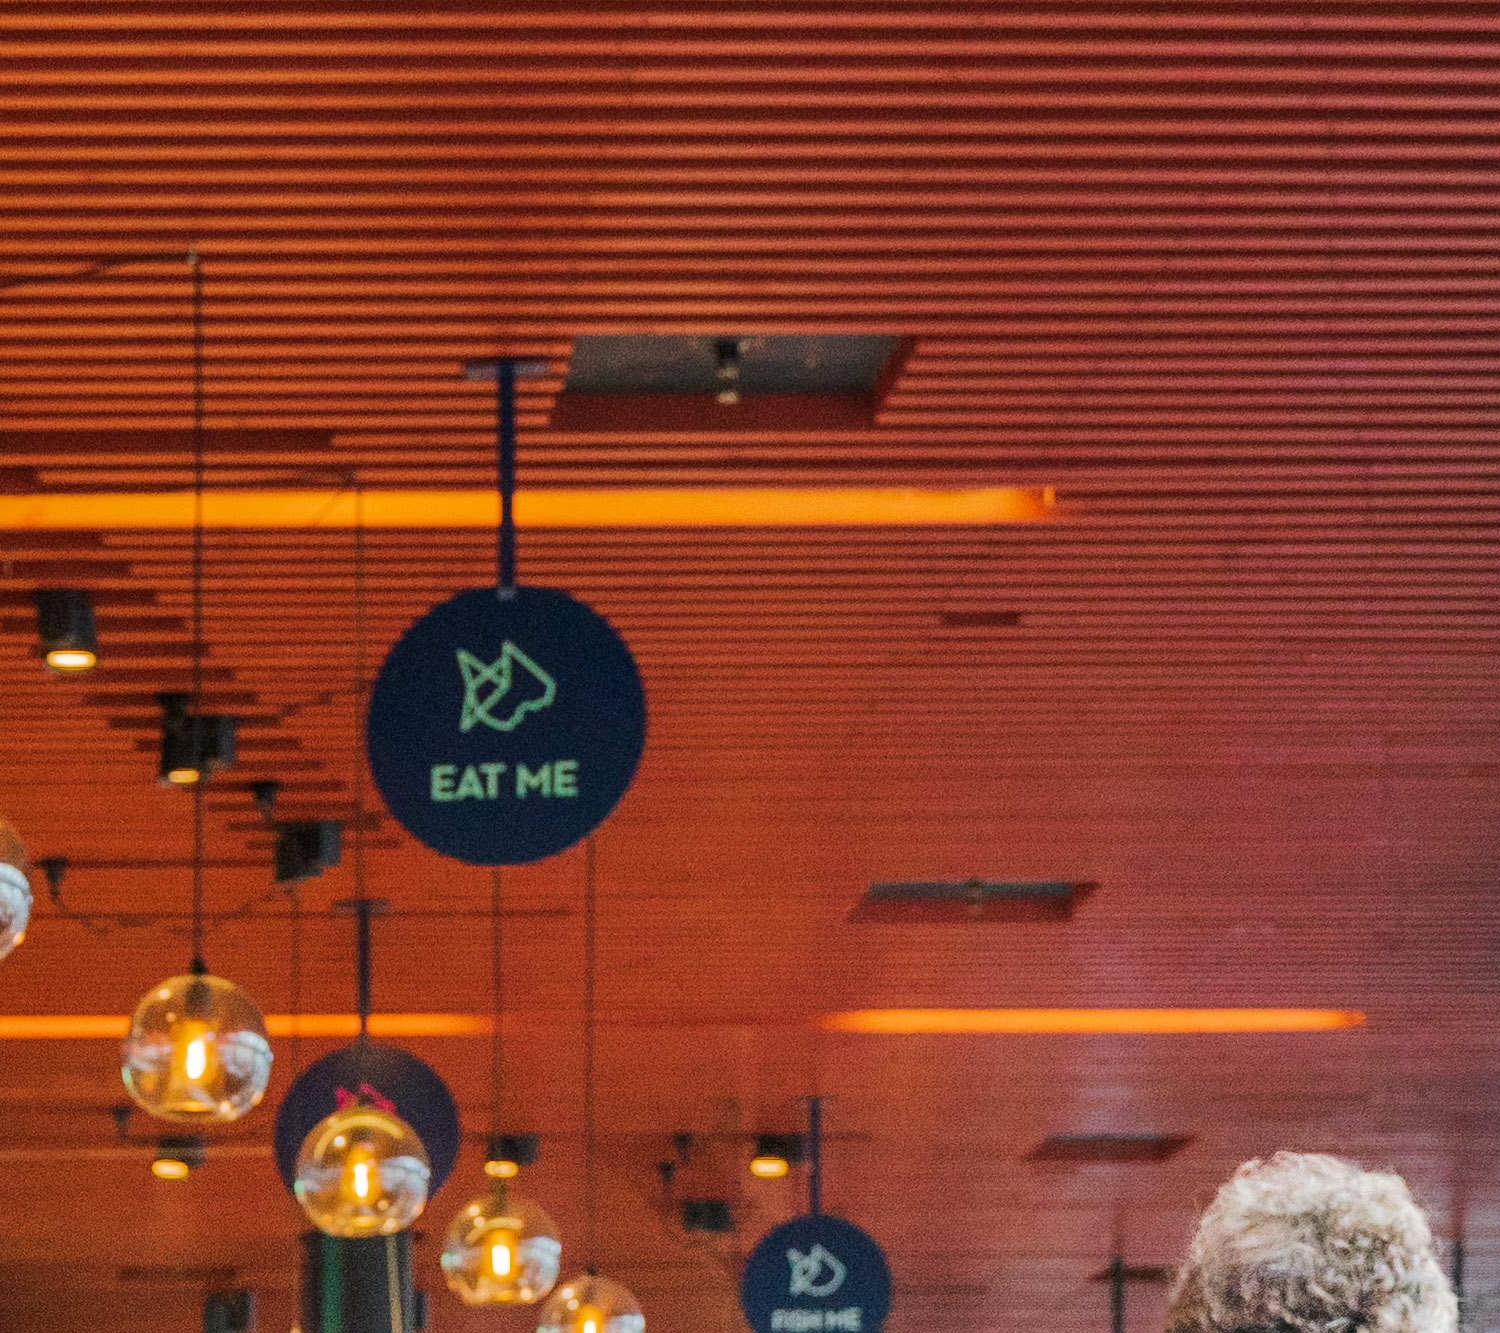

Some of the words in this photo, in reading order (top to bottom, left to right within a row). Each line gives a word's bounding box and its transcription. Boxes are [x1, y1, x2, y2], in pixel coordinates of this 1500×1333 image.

[430, 763, 507, 802] EAT
[515, 759, 579, 799] ME
[770, 1308, 823, 1332] FISH
[825, 1306, 861, 1332] ME
